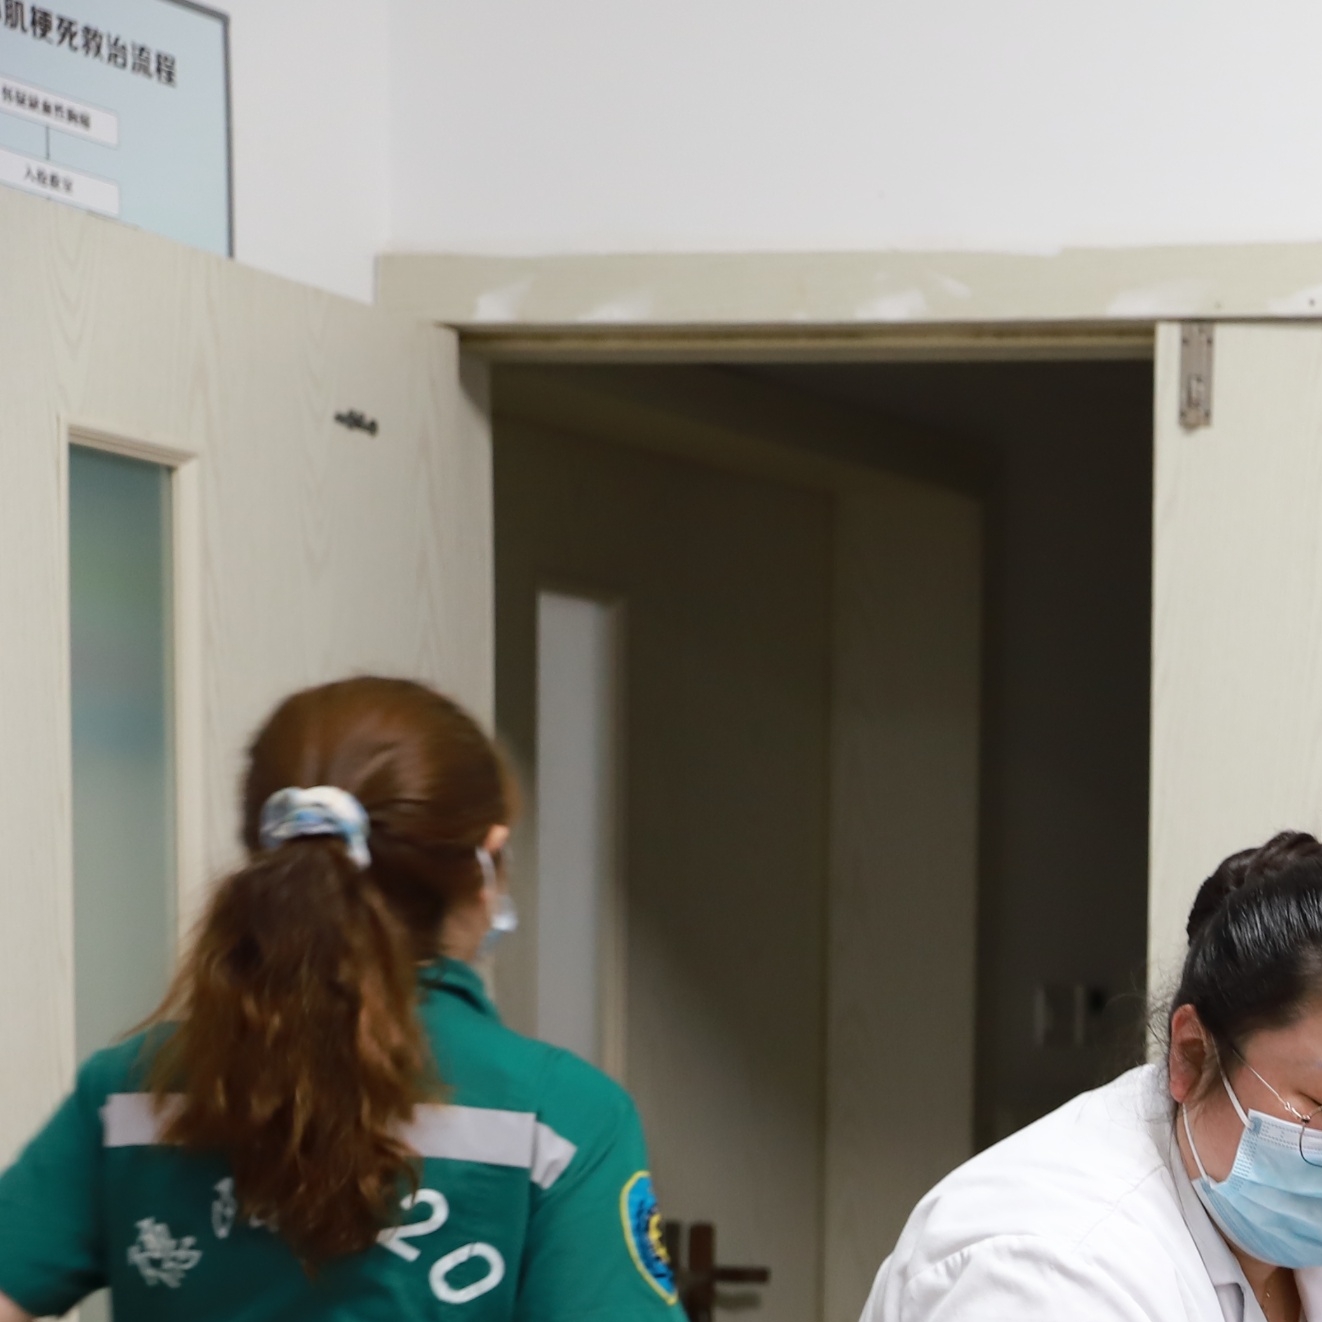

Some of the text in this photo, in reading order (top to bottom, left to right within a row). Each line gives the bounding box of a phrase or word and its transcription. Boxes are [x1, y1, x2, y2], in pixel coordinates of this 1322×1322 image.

[0, 0, 178, 88] 肌梗死救治流程
